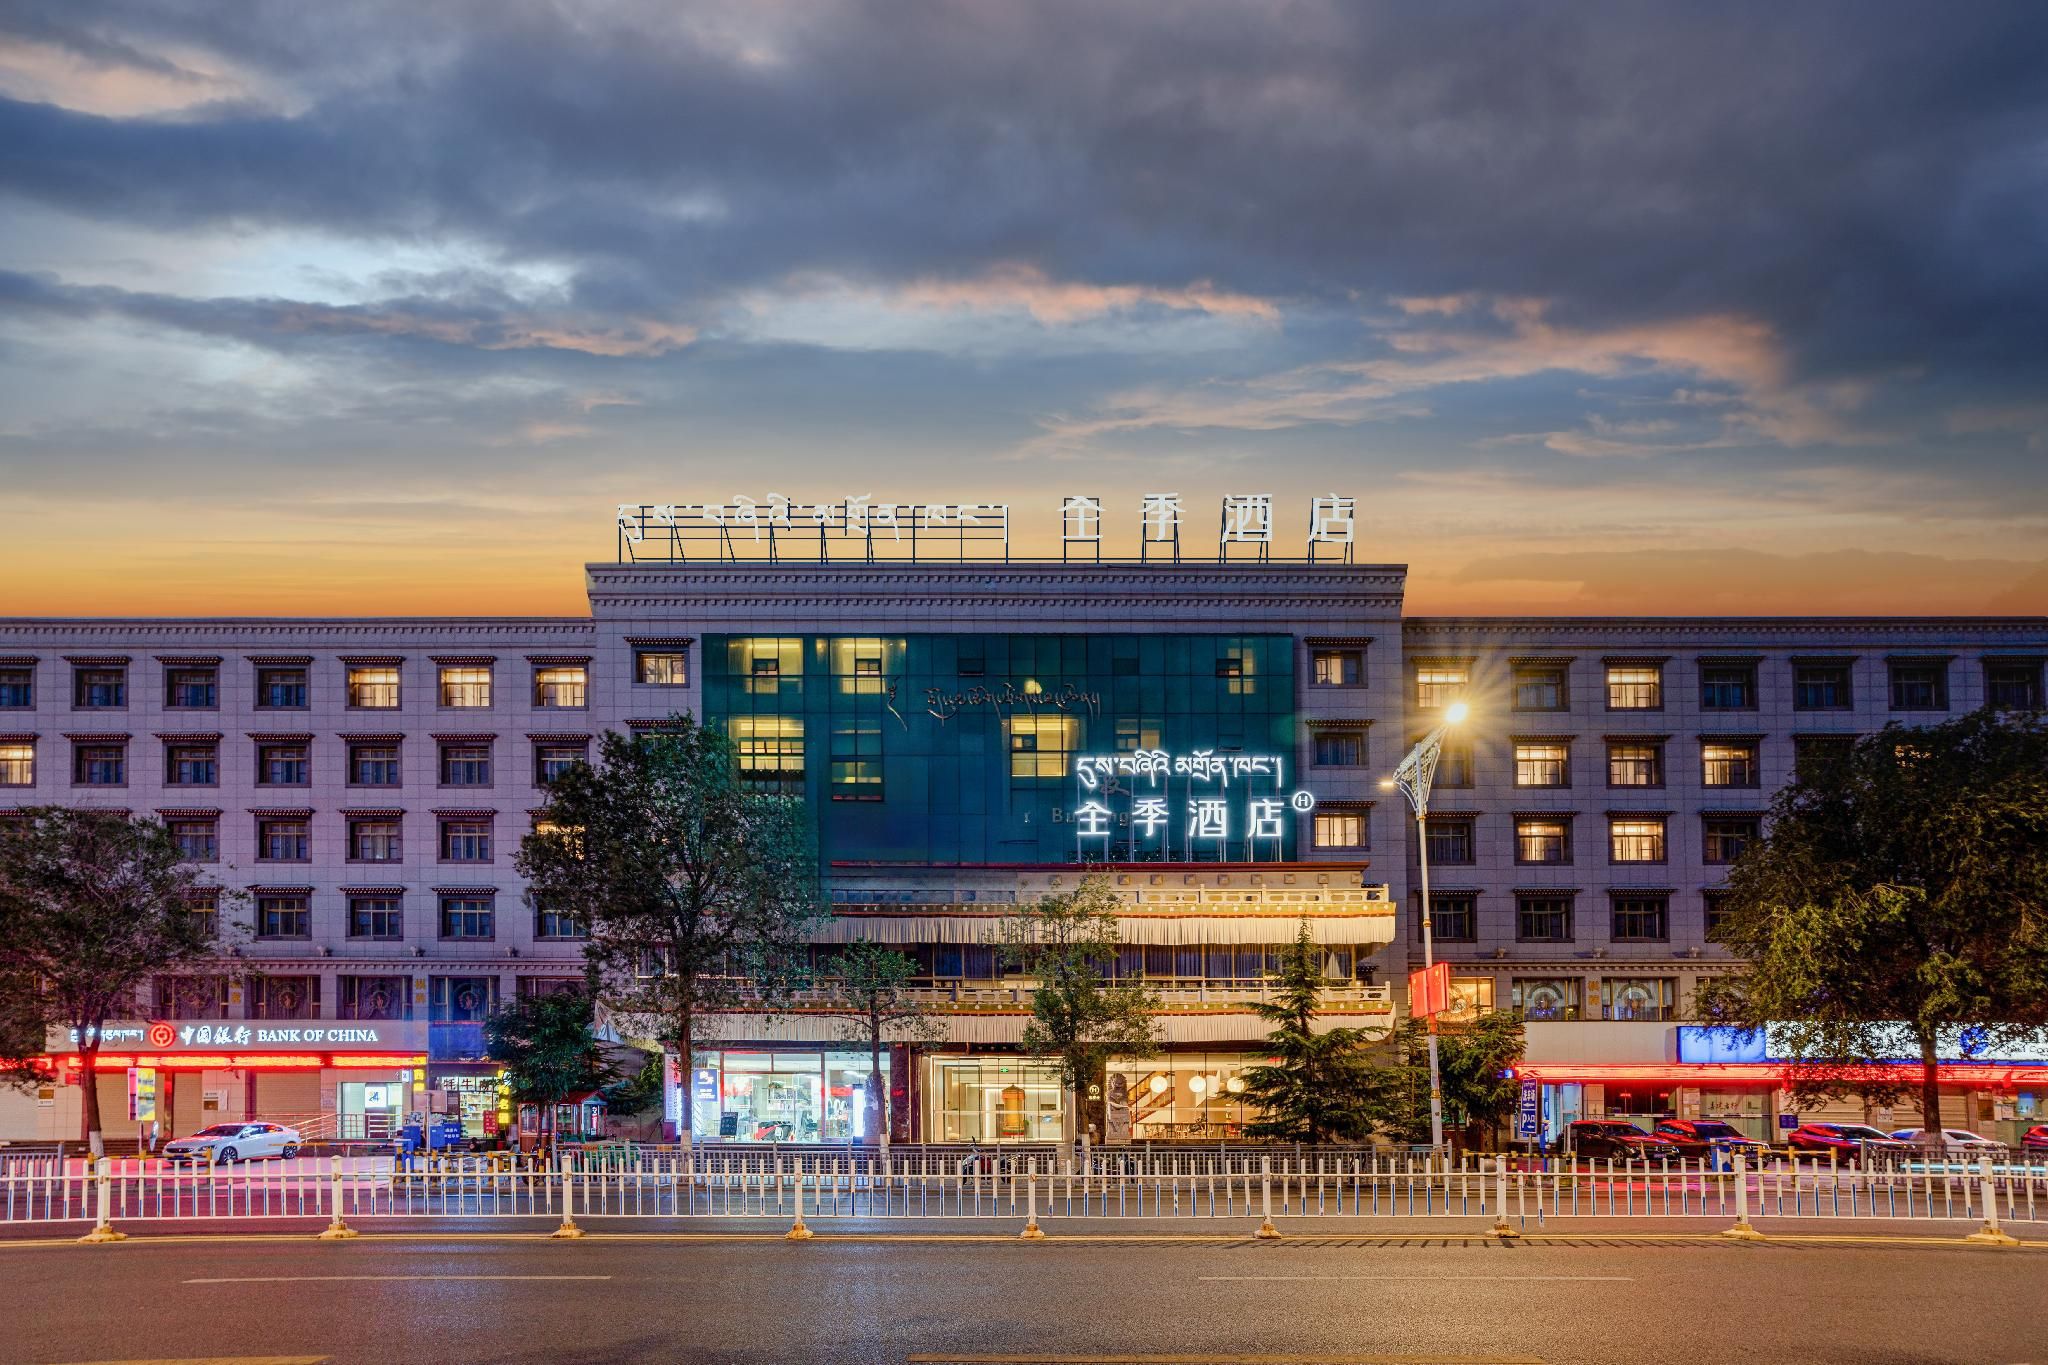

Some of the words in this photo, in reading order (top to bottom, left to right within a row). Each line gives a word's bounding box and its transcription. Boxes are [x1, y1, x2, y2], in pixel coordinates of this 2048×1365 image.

[1057, 492, 1358, 544] 全季酒店
[1075, 798, 1285, 838] 全季酒店
[257, 1029, 301, 1042] BANK
[303, 1029, 324, 1042] OF
[327, 1029, 378, 1042] CHINA
